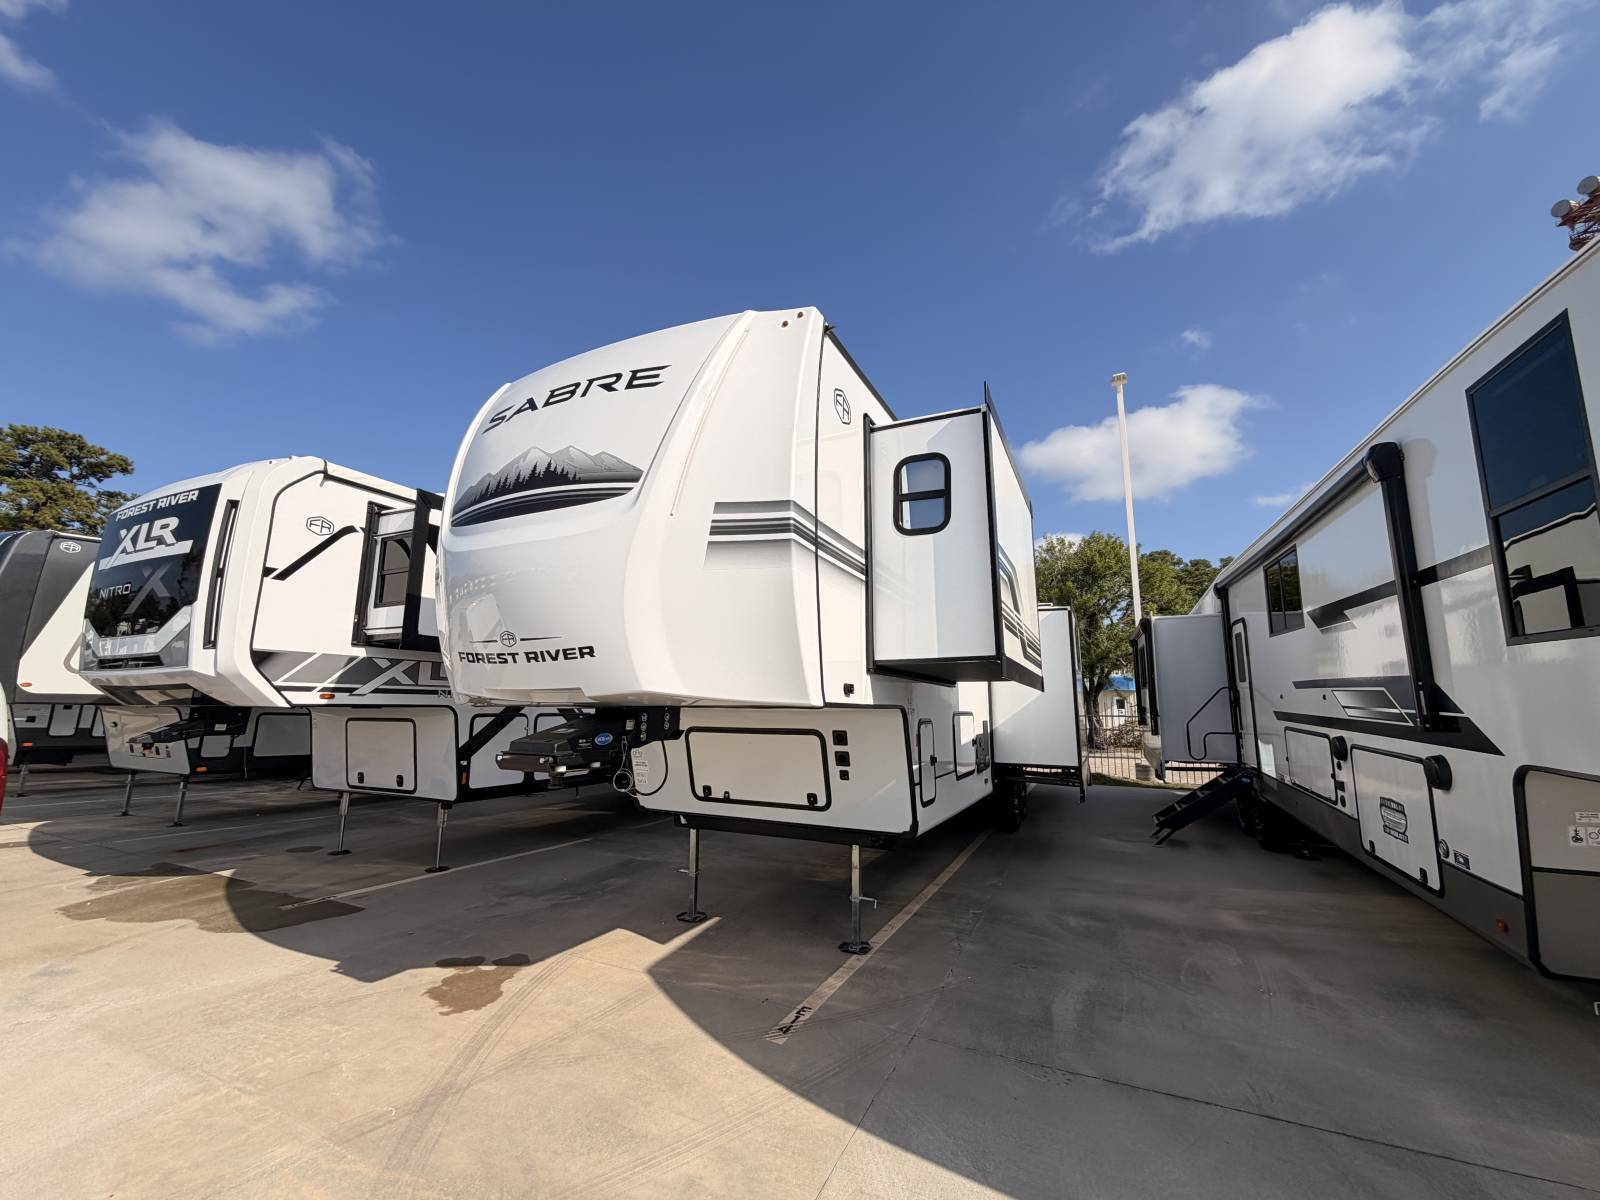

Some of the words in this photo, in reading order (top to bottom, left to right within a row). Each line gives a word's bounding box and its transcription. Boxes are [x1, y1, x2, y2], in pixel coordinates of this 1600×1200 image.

[482, 364, 672, 435] SABRE
[115, 500, 157, 521] FOREST
[157, 489, 199, 509] RIVER
[104, 516, 180, 568] XLR
[100, 583, 132, 600] NITRO
[458, 651, 520, 664] FOREST
[523, 645, 597, 664] RIVER
[350, 657, 451, 696] XL
